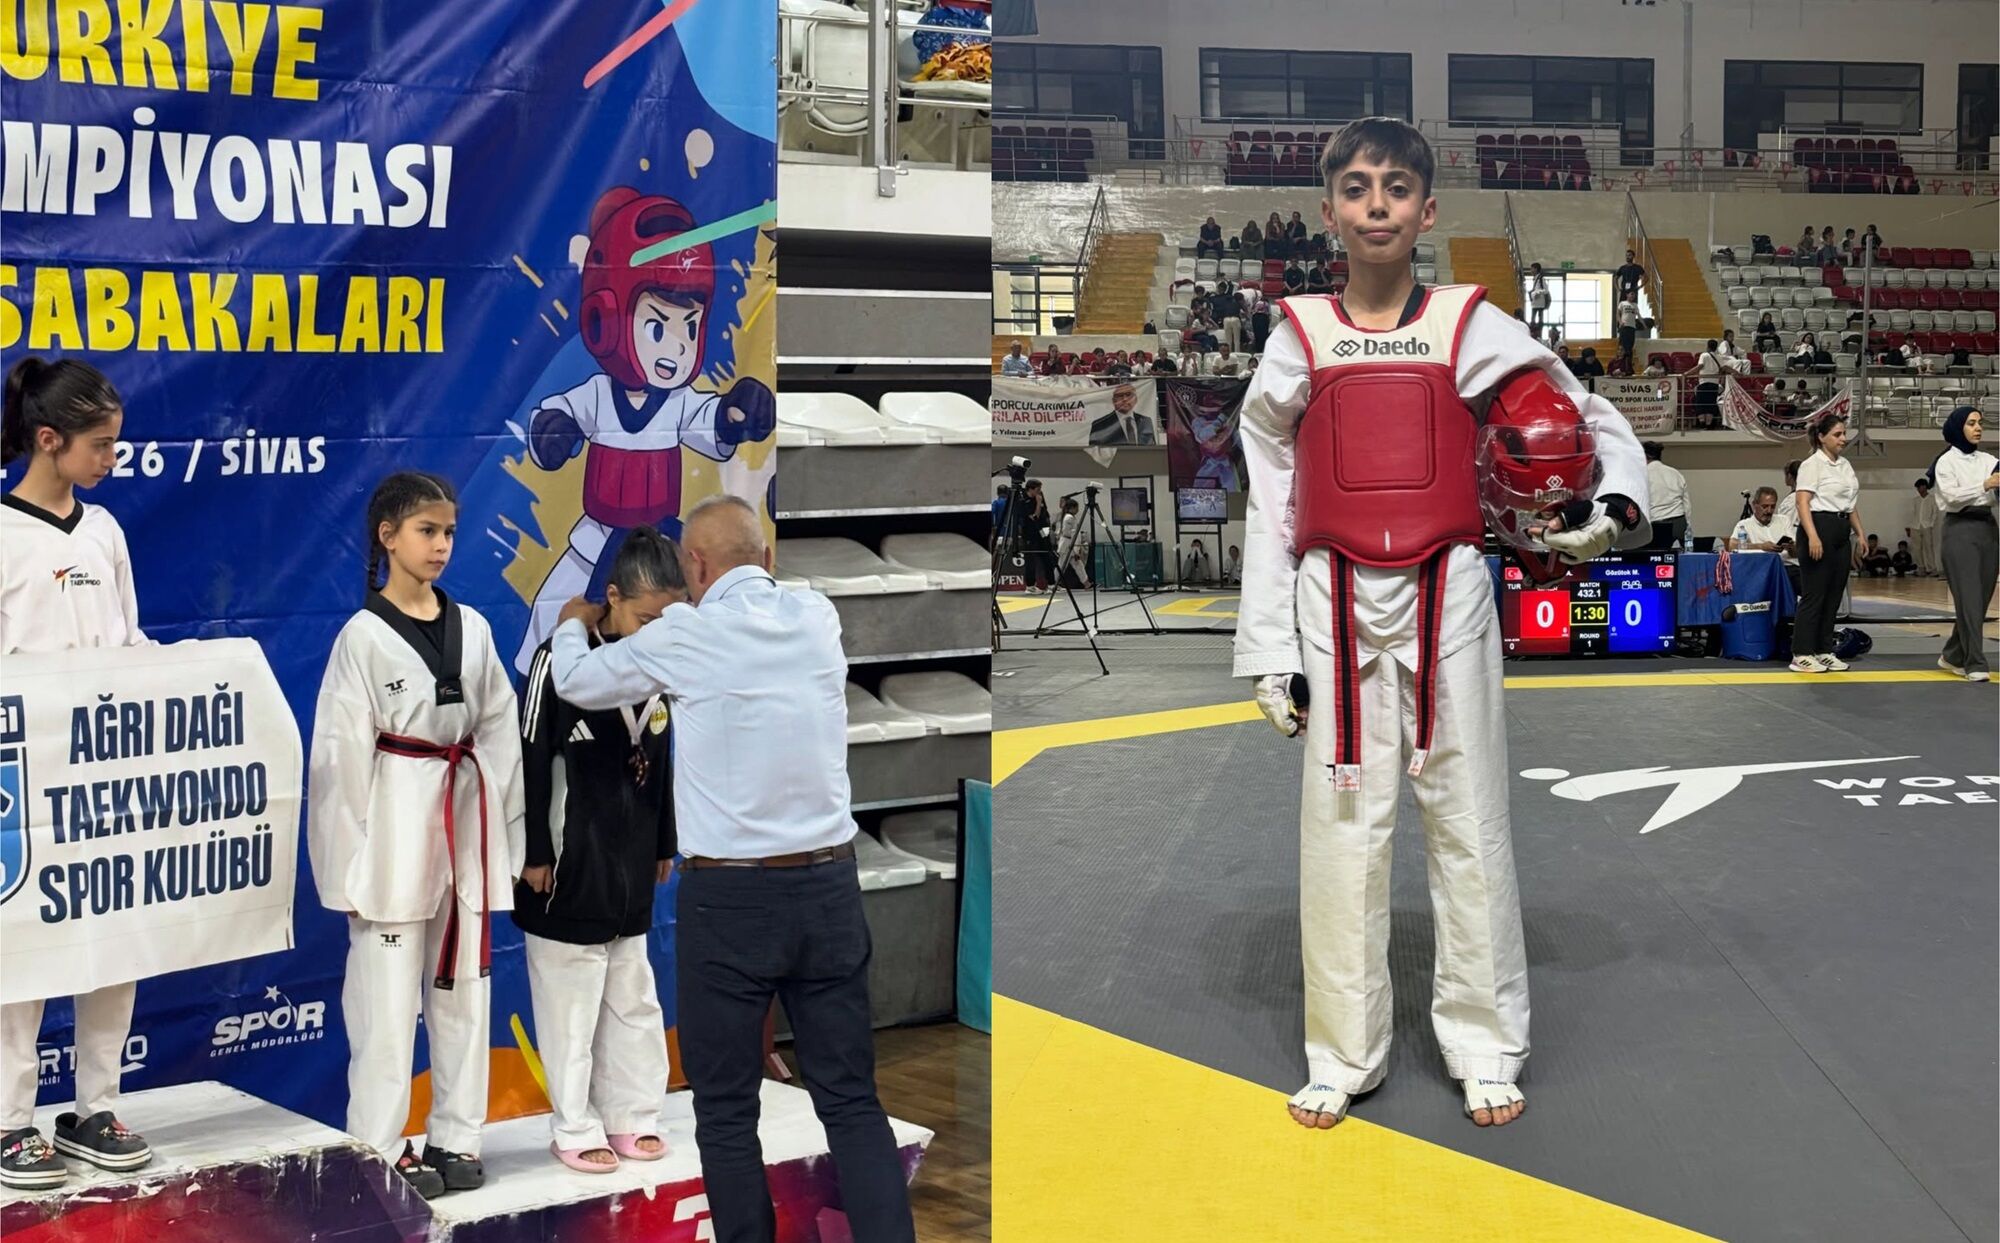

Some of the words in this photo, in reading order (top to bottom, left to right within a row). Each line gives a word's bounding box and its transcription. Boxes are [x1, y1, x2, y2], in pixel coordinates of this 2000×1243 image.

[1, 107, 453, 228] MPİYONASI
[0, 264, 446, 353] SABAKALARI
[1364, 337, 1430, 355] Daedo
[1620, 384, 1651, 393] SİVAS
[1028, 429, 1056, 437] Şimşek
[221, 429, 326, 476] SİVAS
[1577, 589, 1601, 597] 432.1
[1536, 600, 1554, 628] 0
[1574, 607, 1605, 620] 1:30
[1625, 599, 1642, 626] 0
[1509, 642, 1515, 650] 0
[1587, 640, 1592, 648] 1
[1663, 640, 1669, 648] 0
[69, 693, 155, 765] AĞRI
[164, 682, 244, 753] DAĞI
[44, 761, 268, 845] TAEKWONDO
[1842, 791, 1999, 807] TAE
[38, 854, 134, 924] SPOR
[143, 823, 273, 906] KULÜBÜ
[212, 1001, 326, 1046] SPOR
[210, 1043, 246, 1058] GENEL
[250, 1029, 324, 1050] MÜDÜRLÜĞÜ
